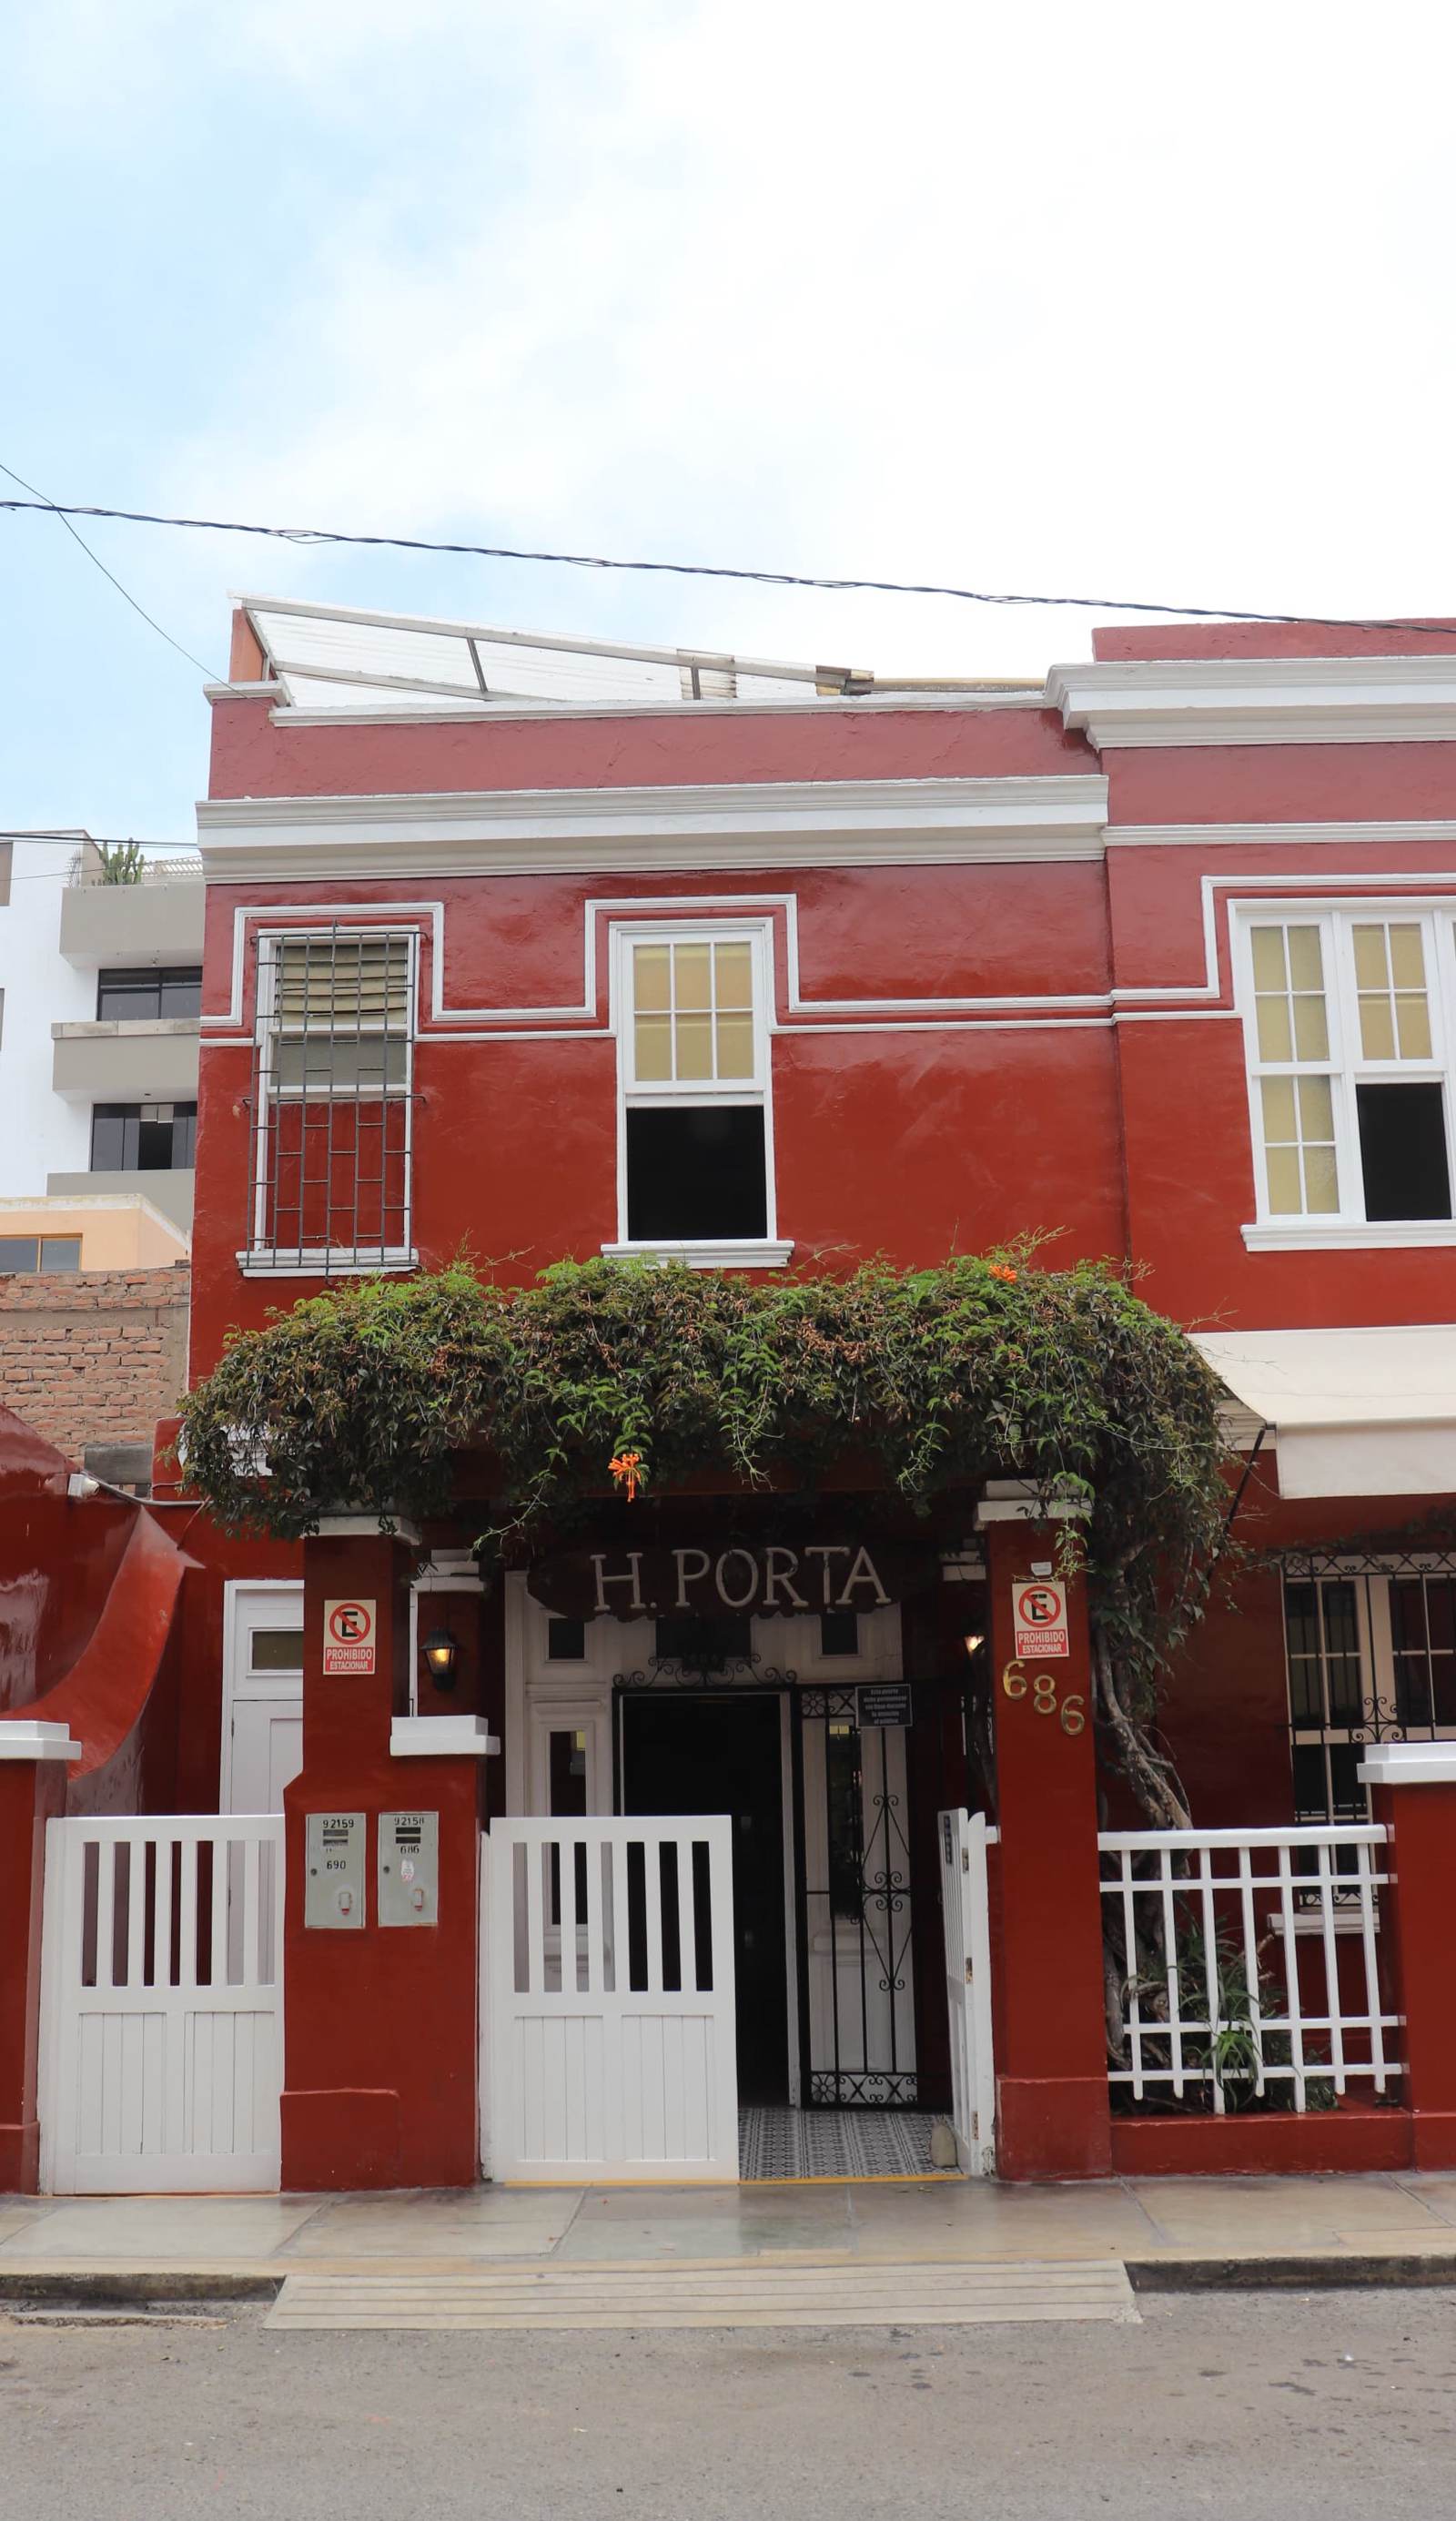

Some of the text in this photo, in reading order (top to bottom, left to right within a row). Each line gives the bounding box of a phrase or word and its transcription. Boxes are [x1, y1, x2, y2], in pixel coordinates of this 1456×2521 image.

[672, 1545, 892, 1608] PORTA
[1018, 1631, 1066, 1644] PROHIBIDO
[327, 1648, 372, 1661] PROHIBIDO
[1022, 1644, 1063, 1655] ESTACIONAR
[329, 1661, 369, 1671] ESTACIONAR
[1003, 1660, 1085, 1736] 686
[323, 1818, 355, 1828] 92159
[326, 1859, 347, 1870] 690
